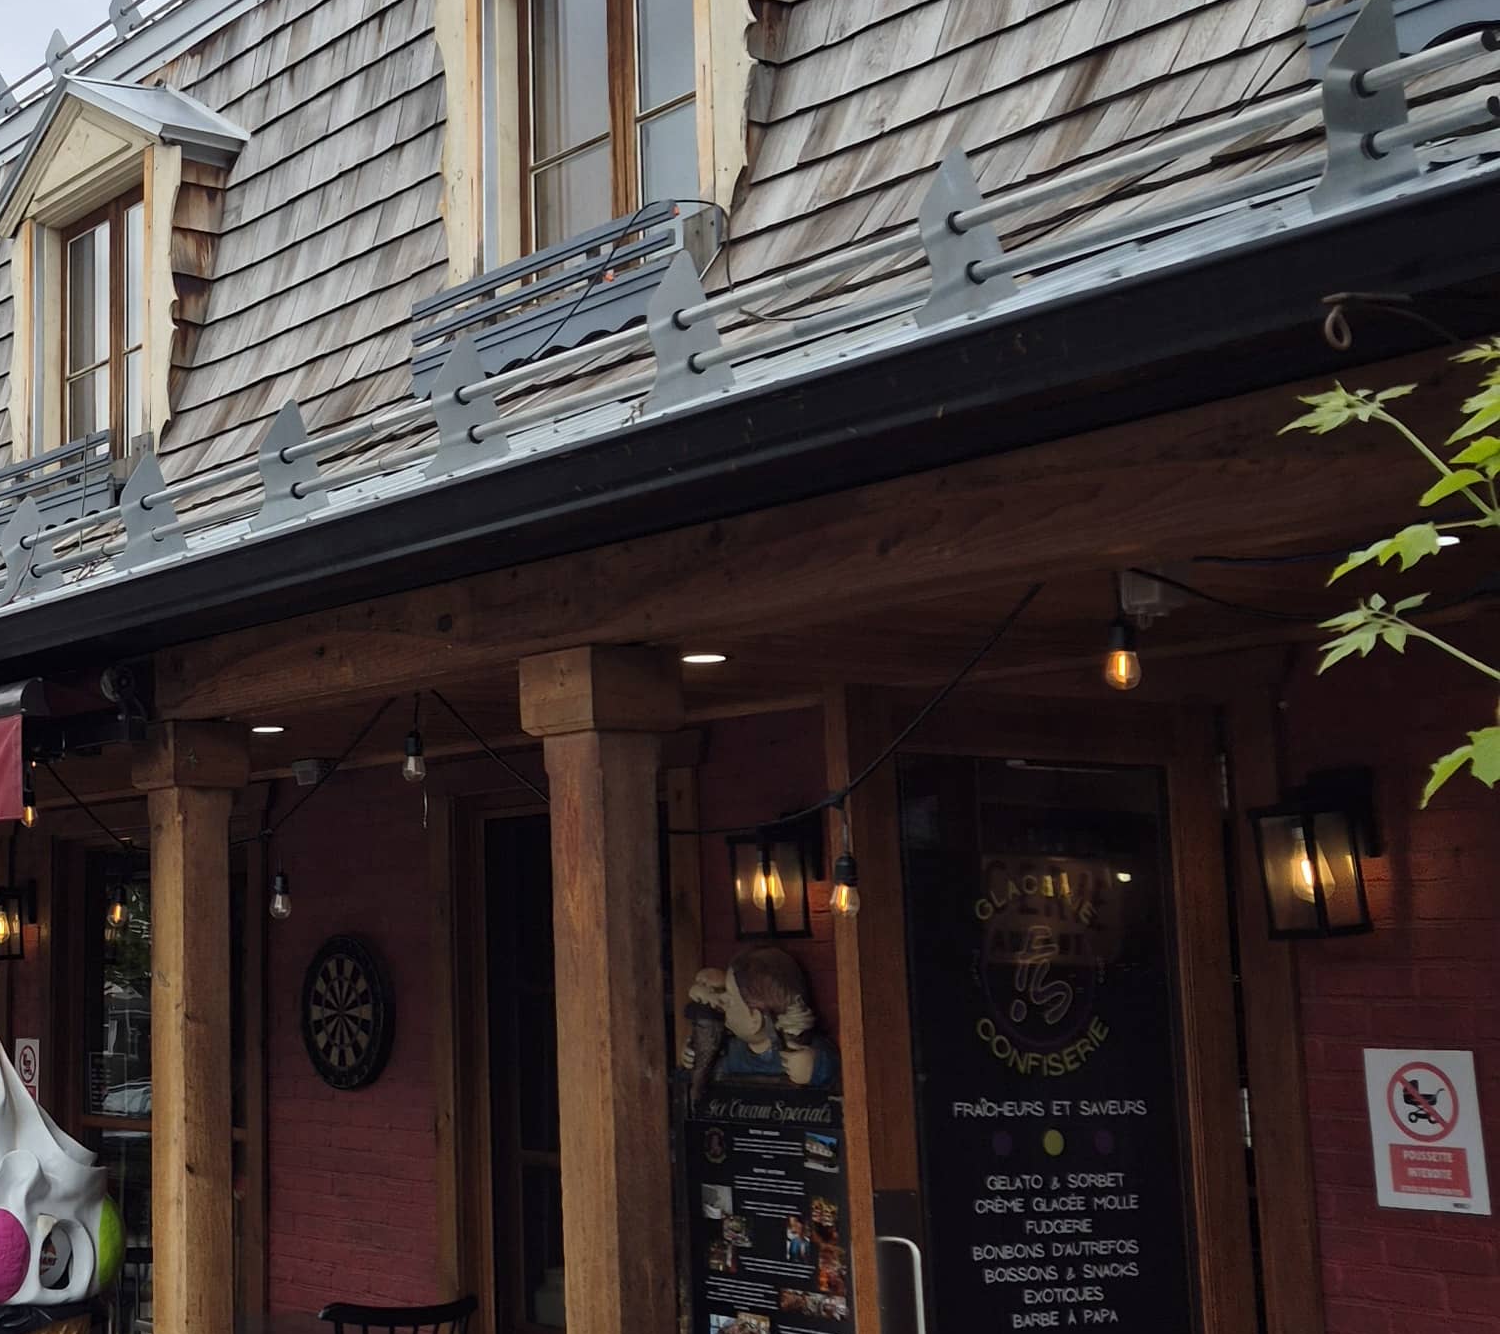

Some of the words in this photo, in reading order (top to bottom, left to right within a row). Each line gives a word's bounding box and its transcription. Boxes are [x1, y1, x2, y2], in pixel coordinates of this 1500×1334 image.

[977, 1017, 1109, 1076] CONFISERIE
[729, 1099, 772, 1118] Cream
[772, 1100, 832, 1123] Specials
[953, 1098, 1045, 1117] FRAÎCHEURS
[1052, 1101, 1071, 1115] ET
[1079, 1100, 1147, 1116] SAVEURS
[986, 1175, 1043, 1191] GELATO
[1051, 1177, 1060, 1190] &
[1067, 1172, 1125, 1188] SORBET
[975, 1196, 1025, 1214] CRÈME
[1033, 1194, 1086, 1212] GLACÉE
[1094, 1195, 1139, 1211] MOLLE
[972, 1243, 1045, 1261] BONBONS
[1052, 1240, 1139, 1257] D'AUTREFOIS
[985, 1266, 1059, 1283] BOISSONS
[1066, 1267, 1076, 1280] &
[1083, 1263, 1139, 1279] SNACKS
[1024, 1286, 1104, 1304] EXOTIQUES
[1012, 1311, 1059, 1328] BARBE
[1084, 1309, 1118, 1324] PAPA
